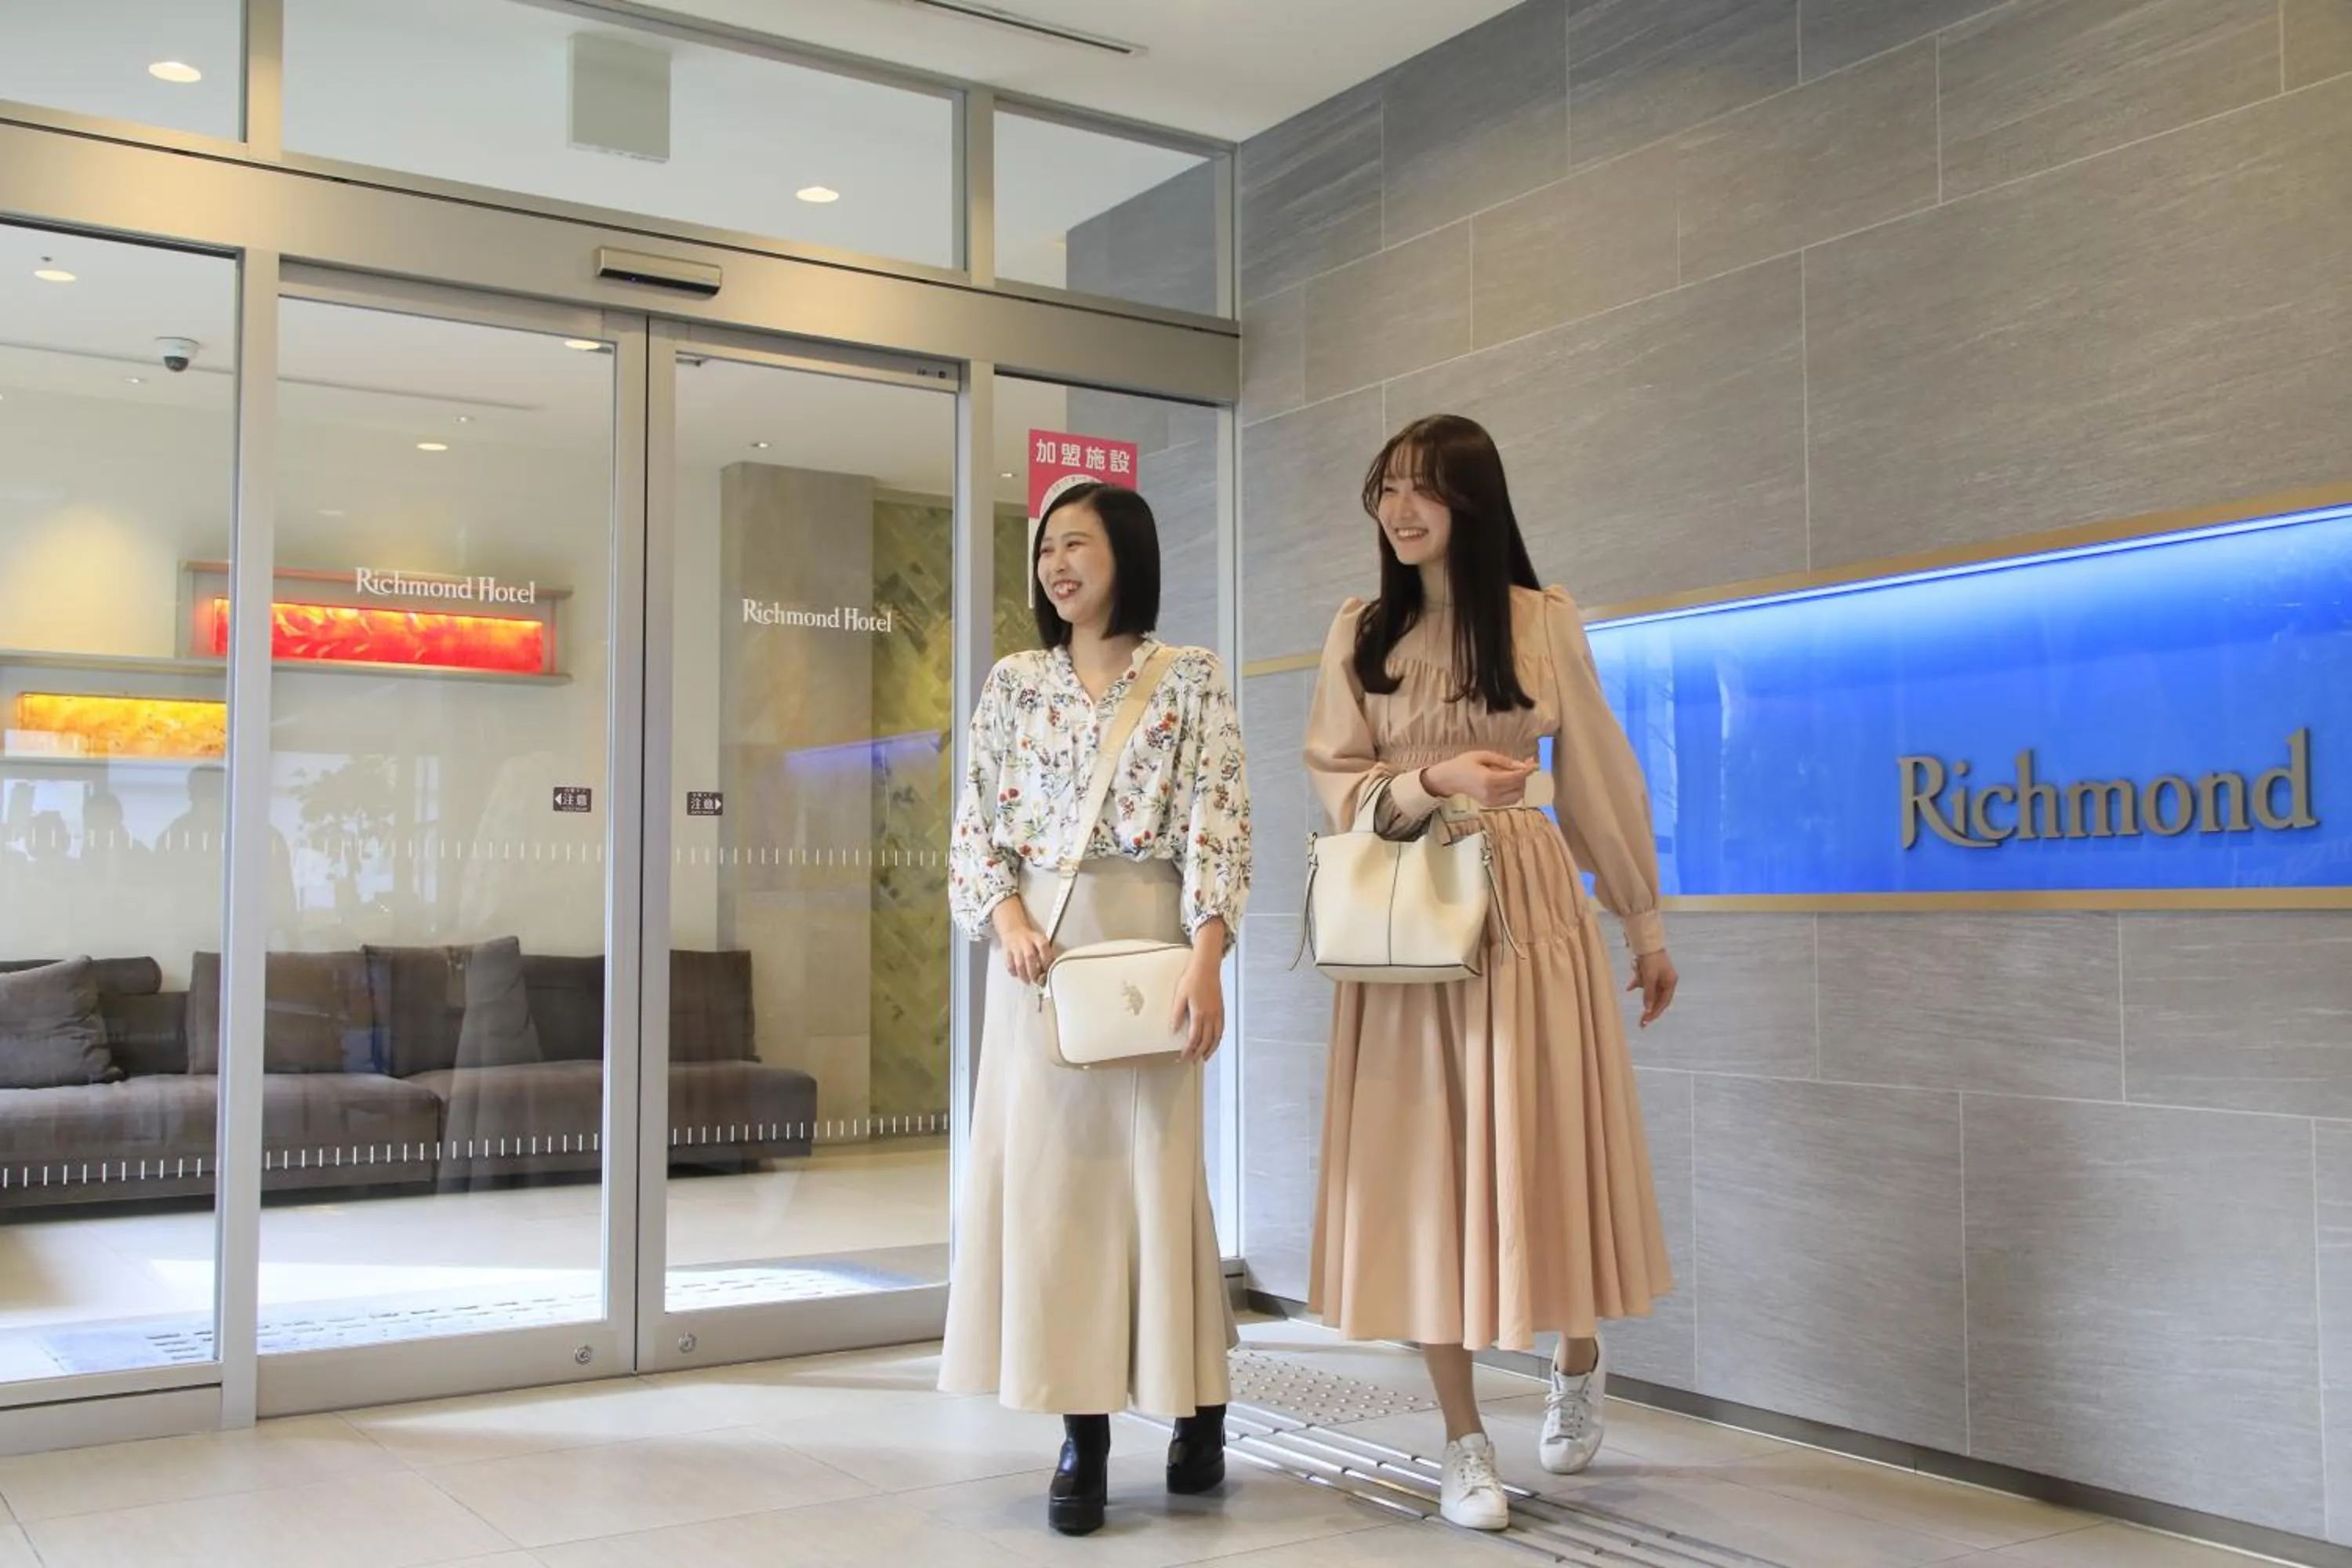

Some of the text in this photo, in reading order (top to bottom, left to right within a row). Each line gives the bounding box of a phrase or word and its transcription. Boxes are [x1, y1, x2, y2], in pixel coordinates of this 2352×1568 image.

[1036, 439, 1130, 474] 加盟施設
[355, 567, 536, 604] Richmond Hotel
[742, 598, 891, 633] Richmond Hotel
[1896, 727, 2321, 851] Richmond
